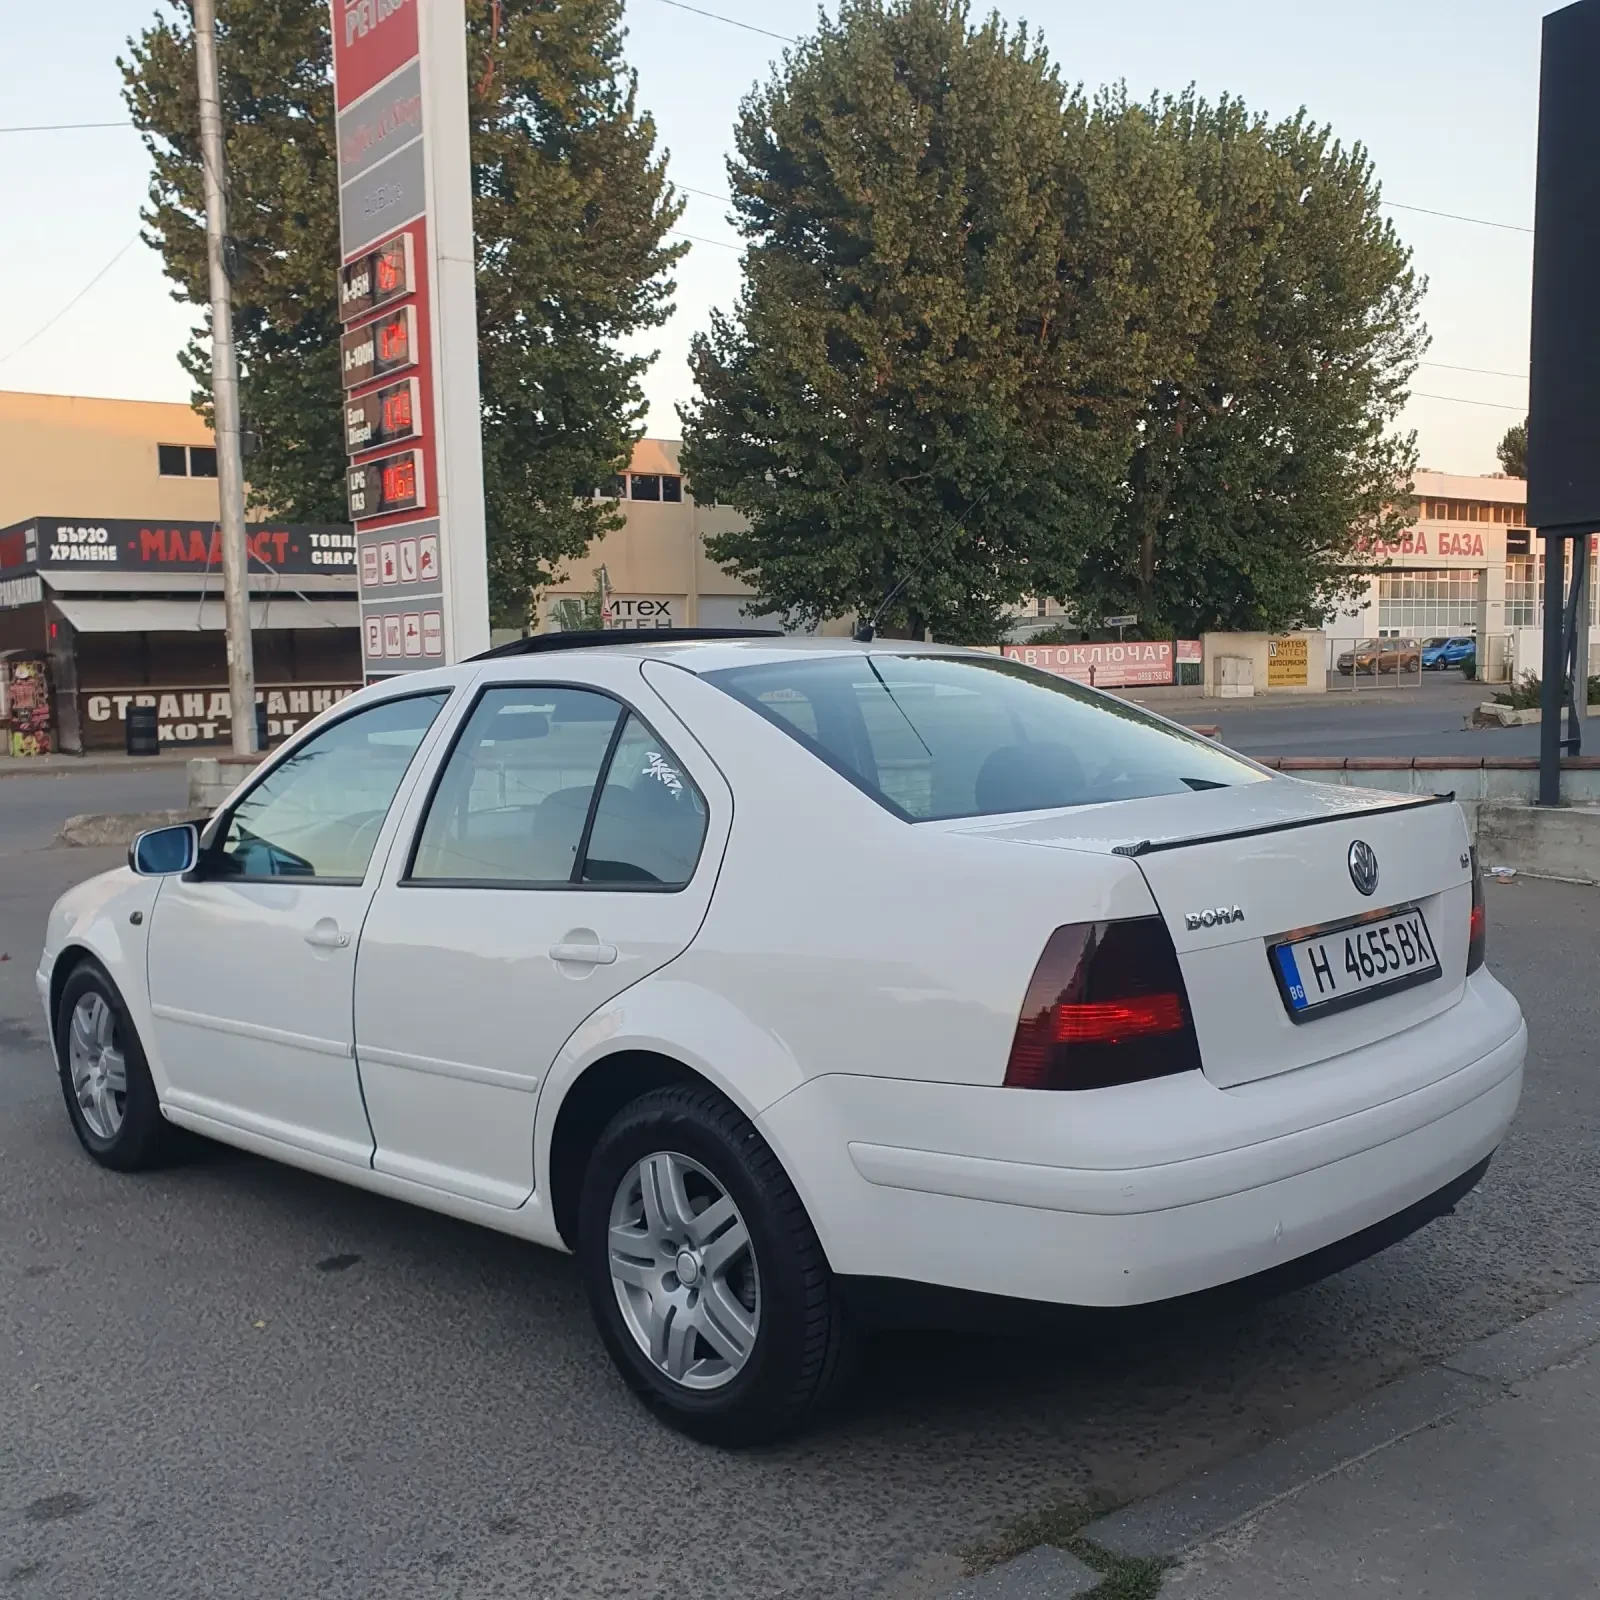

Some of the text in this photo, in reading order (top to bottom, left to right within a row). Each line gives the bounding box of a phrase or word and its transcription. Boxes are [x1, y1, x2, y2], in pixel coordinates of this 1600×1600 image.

[348, 407, 365, 426] Euro
[348, 422, 373, 445] Diesel
[350, 471, 365, 491] LPG
[57, 526, 108, 543] БЪРЗО
[1438, 532, 1485, 556] БАЗА
[1184, 904, 1245, 931] BORA
[1289, 984, 1305, 1001] BG
[1307, 944, 1336, 993] H
